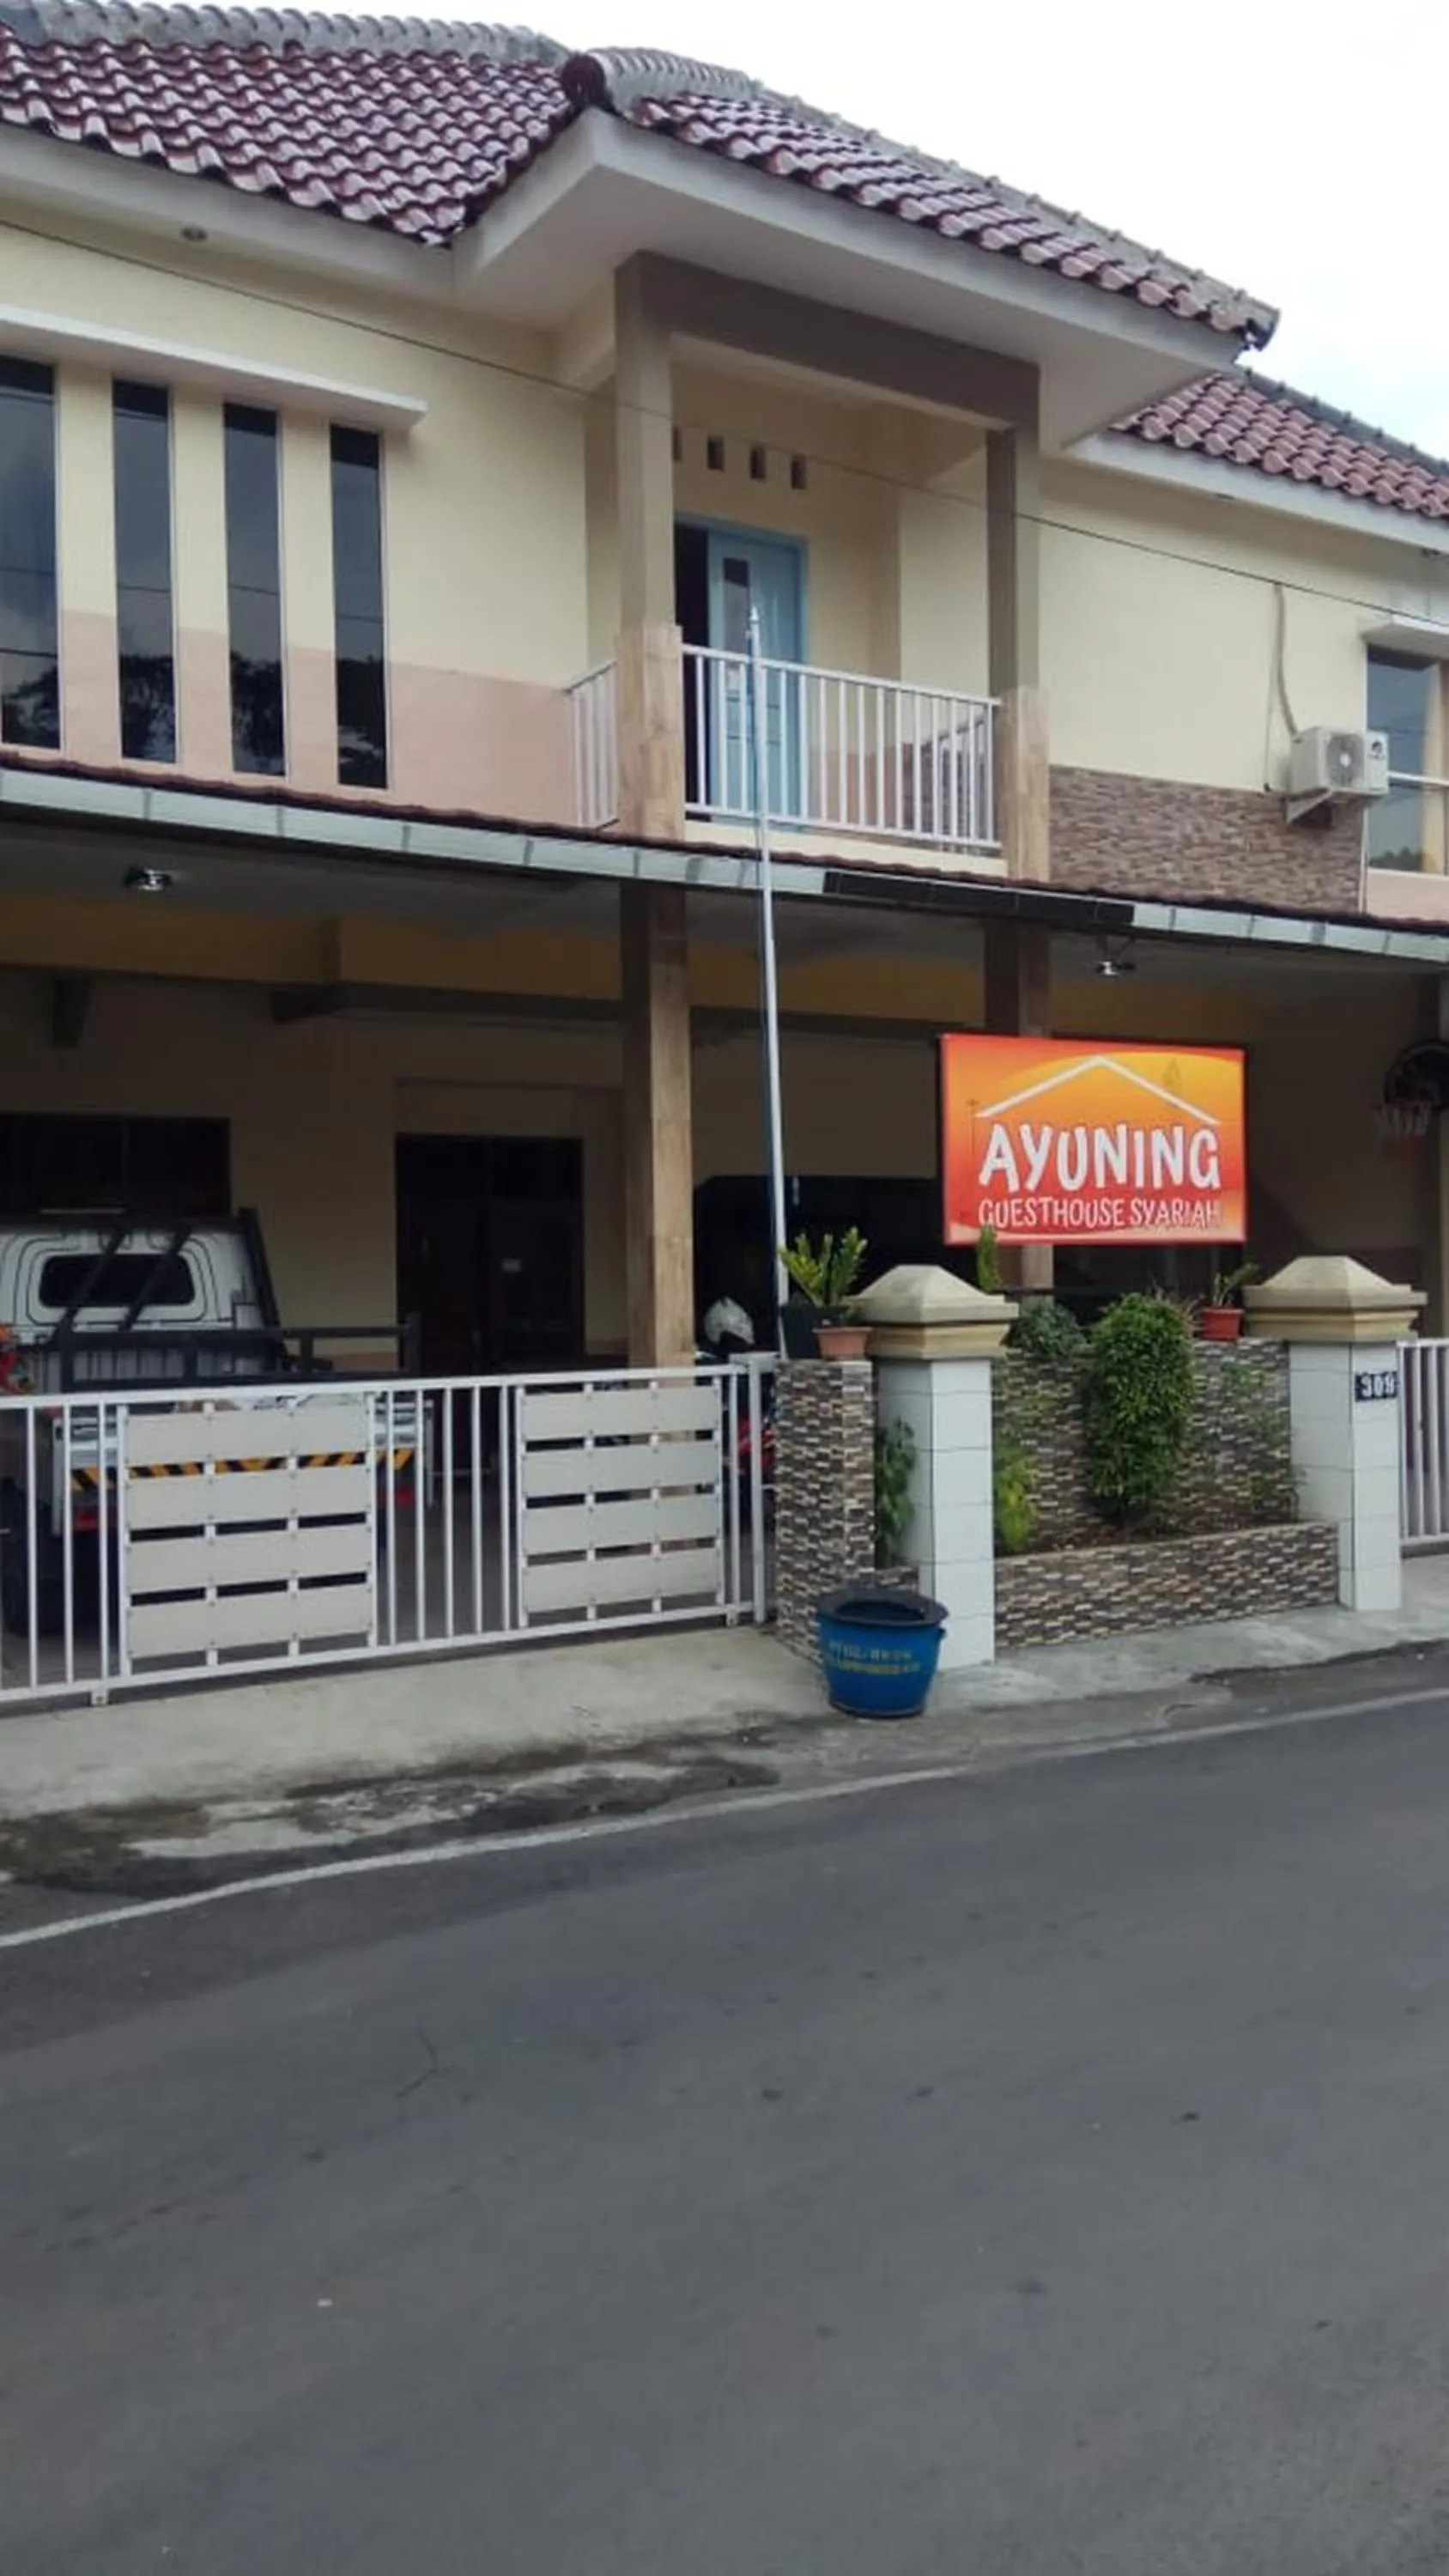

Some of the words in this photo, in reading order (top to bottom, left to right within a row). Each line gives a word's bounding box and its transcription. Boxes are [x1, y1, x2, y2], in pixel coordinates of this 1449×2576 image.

[979, 1123, 1221, 1193] AYUNING
[979, 1197, 1125, 1229] GUESTHOUSE
[1130, 1199, 1219, 1229] SYARIAH
